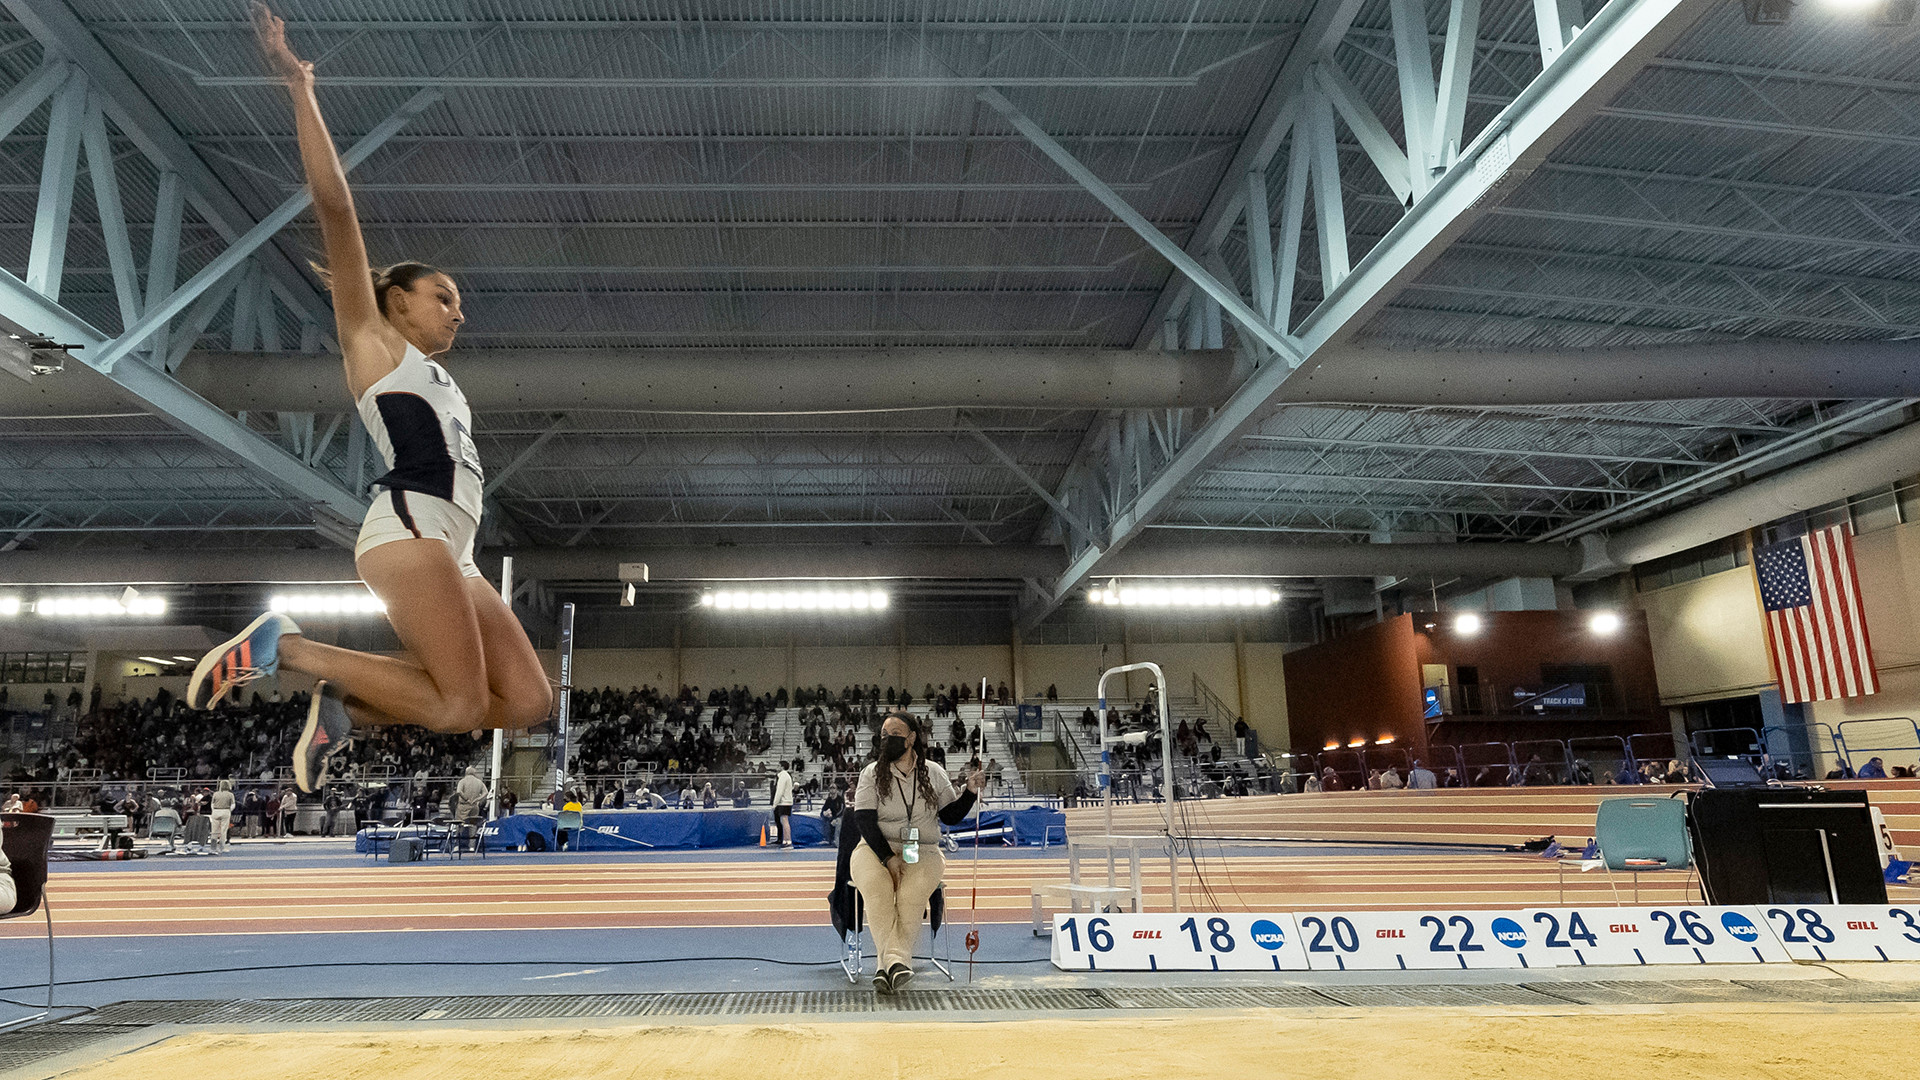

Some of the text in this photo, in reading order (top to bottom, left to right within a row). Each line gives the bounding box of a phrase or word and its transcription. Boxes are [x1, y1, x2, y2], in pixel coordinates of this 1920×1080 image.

[1542, 697, 1562, 705] TRACK
[1567, 697, 1584, 705] FIELD
[556, 768, 564, 791] GILL
[597, 825, 620, 834] GILL
[1879, 823, 1893, 851] 5
[1060, 917, 1286, 953] 16 GILL 18 NCAA
[1301, 915, 1528, 952] 20 GILL 22 NCAA
[1533, 910, 1759, 948] 24 GILL 26 NCAA
[1767, 908, 1920, 944] 28 GILL 3
